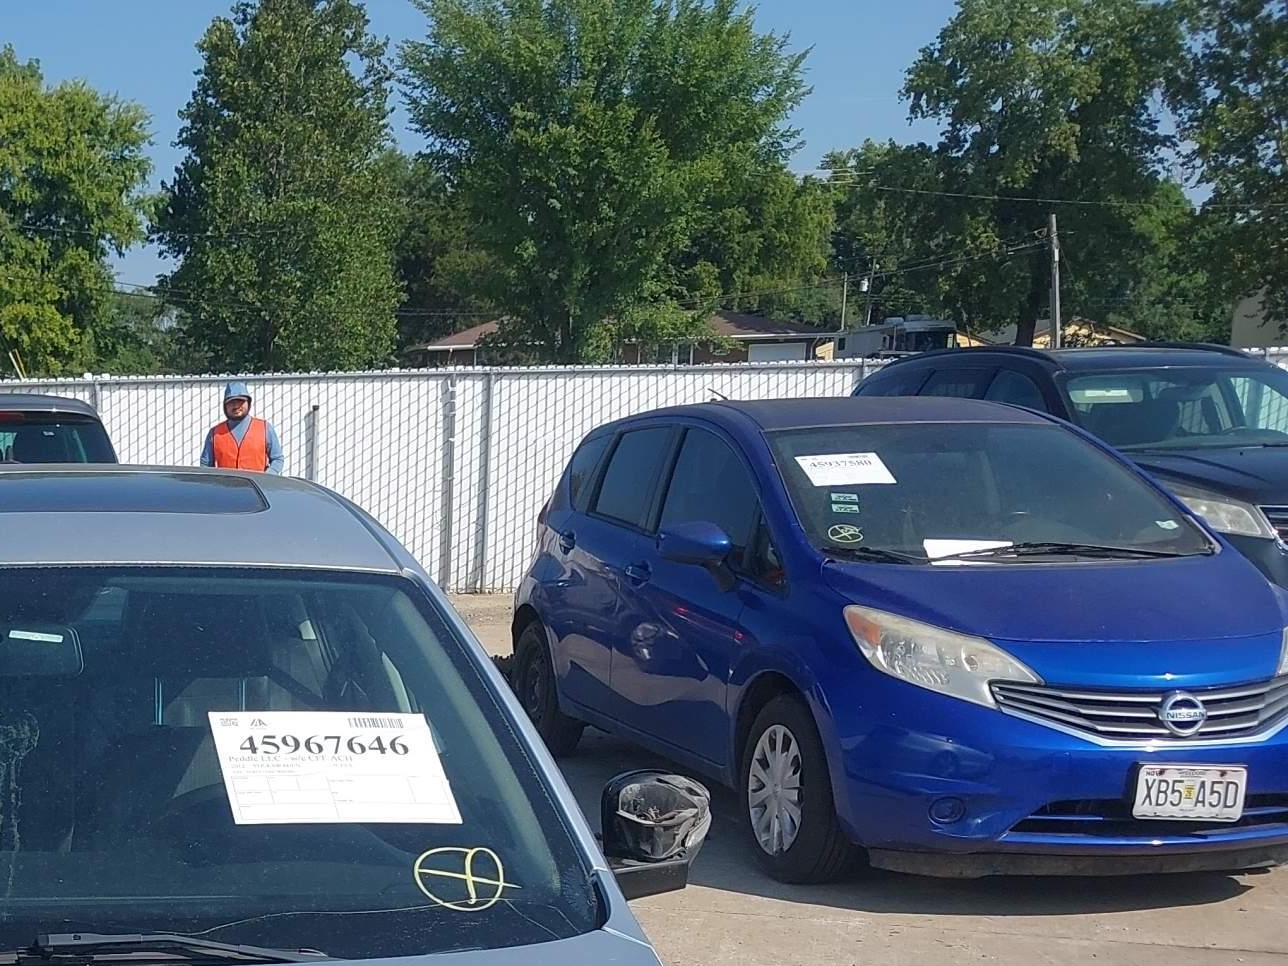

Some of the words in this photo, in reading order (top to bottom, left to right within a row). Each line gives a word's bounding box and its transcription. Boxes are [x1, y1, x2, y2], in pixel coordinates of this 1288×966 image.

[1166, 711, 1205, 720] NISSAN
[239, 734, 409, 756] 45967646
[1141, 778, 1184, 807] XB5
[1194, 780, 1239, 809] A5D
